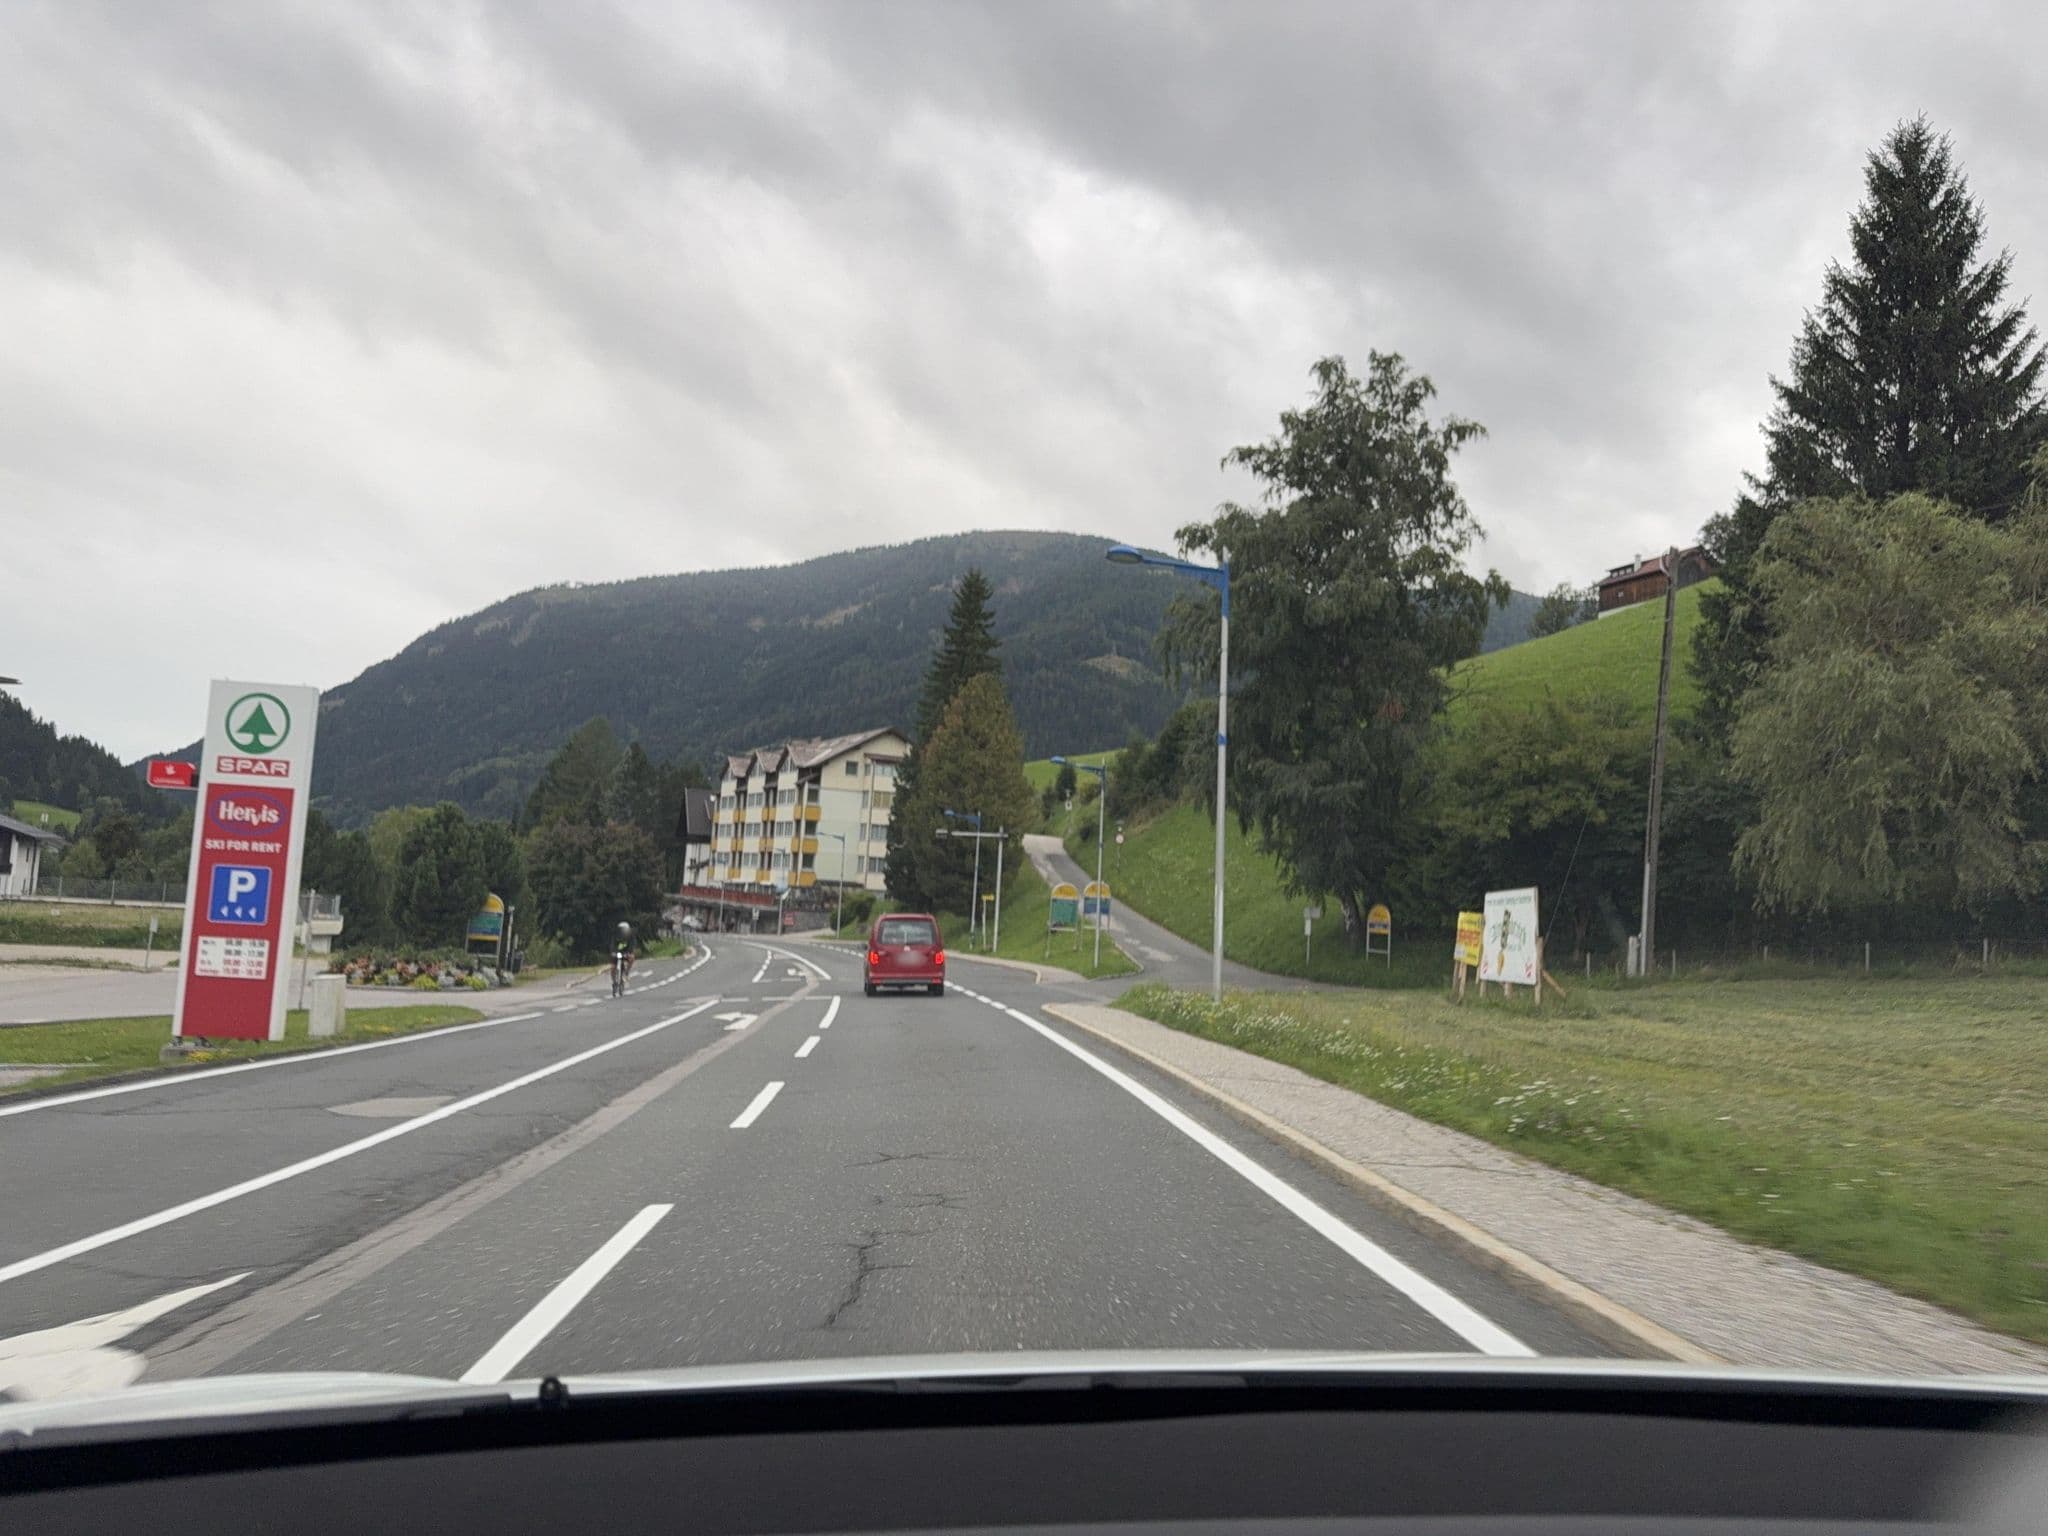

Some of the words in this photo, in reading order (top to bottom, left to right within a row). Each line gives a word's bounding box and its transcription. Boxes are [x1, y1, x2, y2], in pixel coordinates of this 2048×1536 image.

[219, 758, 287, 775] SPAR
[219, 800, 280, 826] Hervis
[205, 838, 225, 851] SKI
[226, 840, 250, 851] FOR
[251, 842, 282, 854] RENT
[228, 869, 257, 903] P
